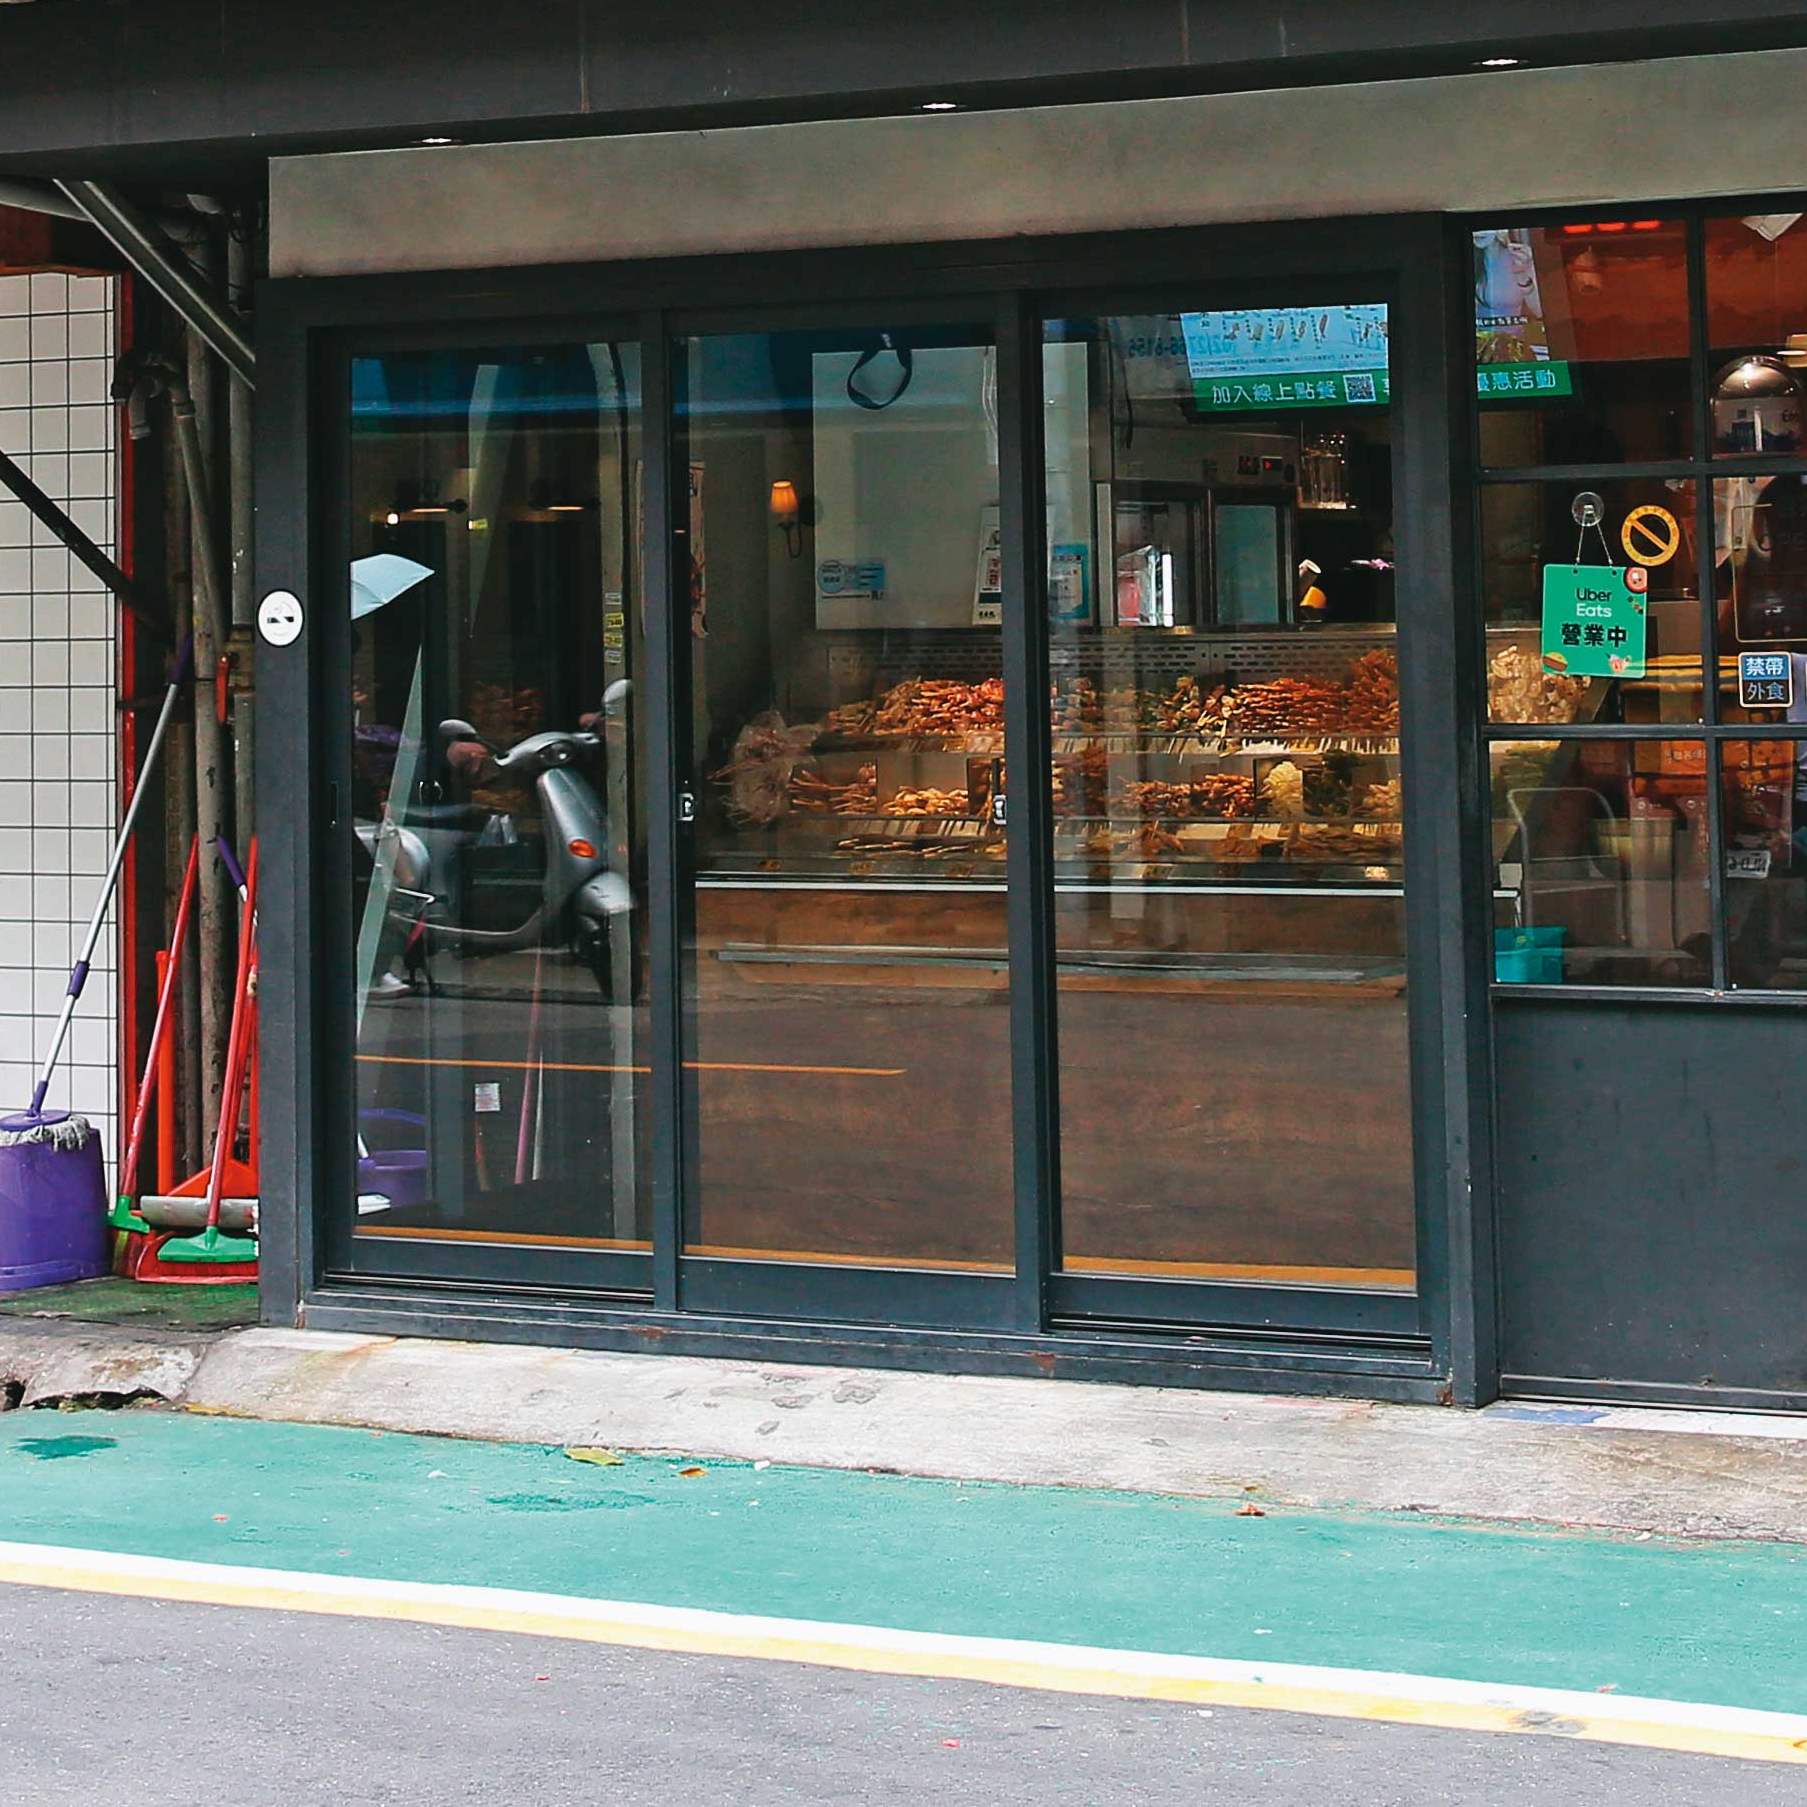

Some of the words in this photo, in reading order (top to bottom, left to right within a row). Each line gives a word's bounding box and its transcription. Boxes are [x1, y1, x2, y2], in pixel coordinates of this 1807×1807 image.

[1576, 587, 1612, 602] Uber
[1576, 603, 1612, 618] Eats
[1561, 623, 1627, 648] 營業中
[1745, 656, 1785, 676] 禁帶
[1747, 681, 1786, 701] 外食
